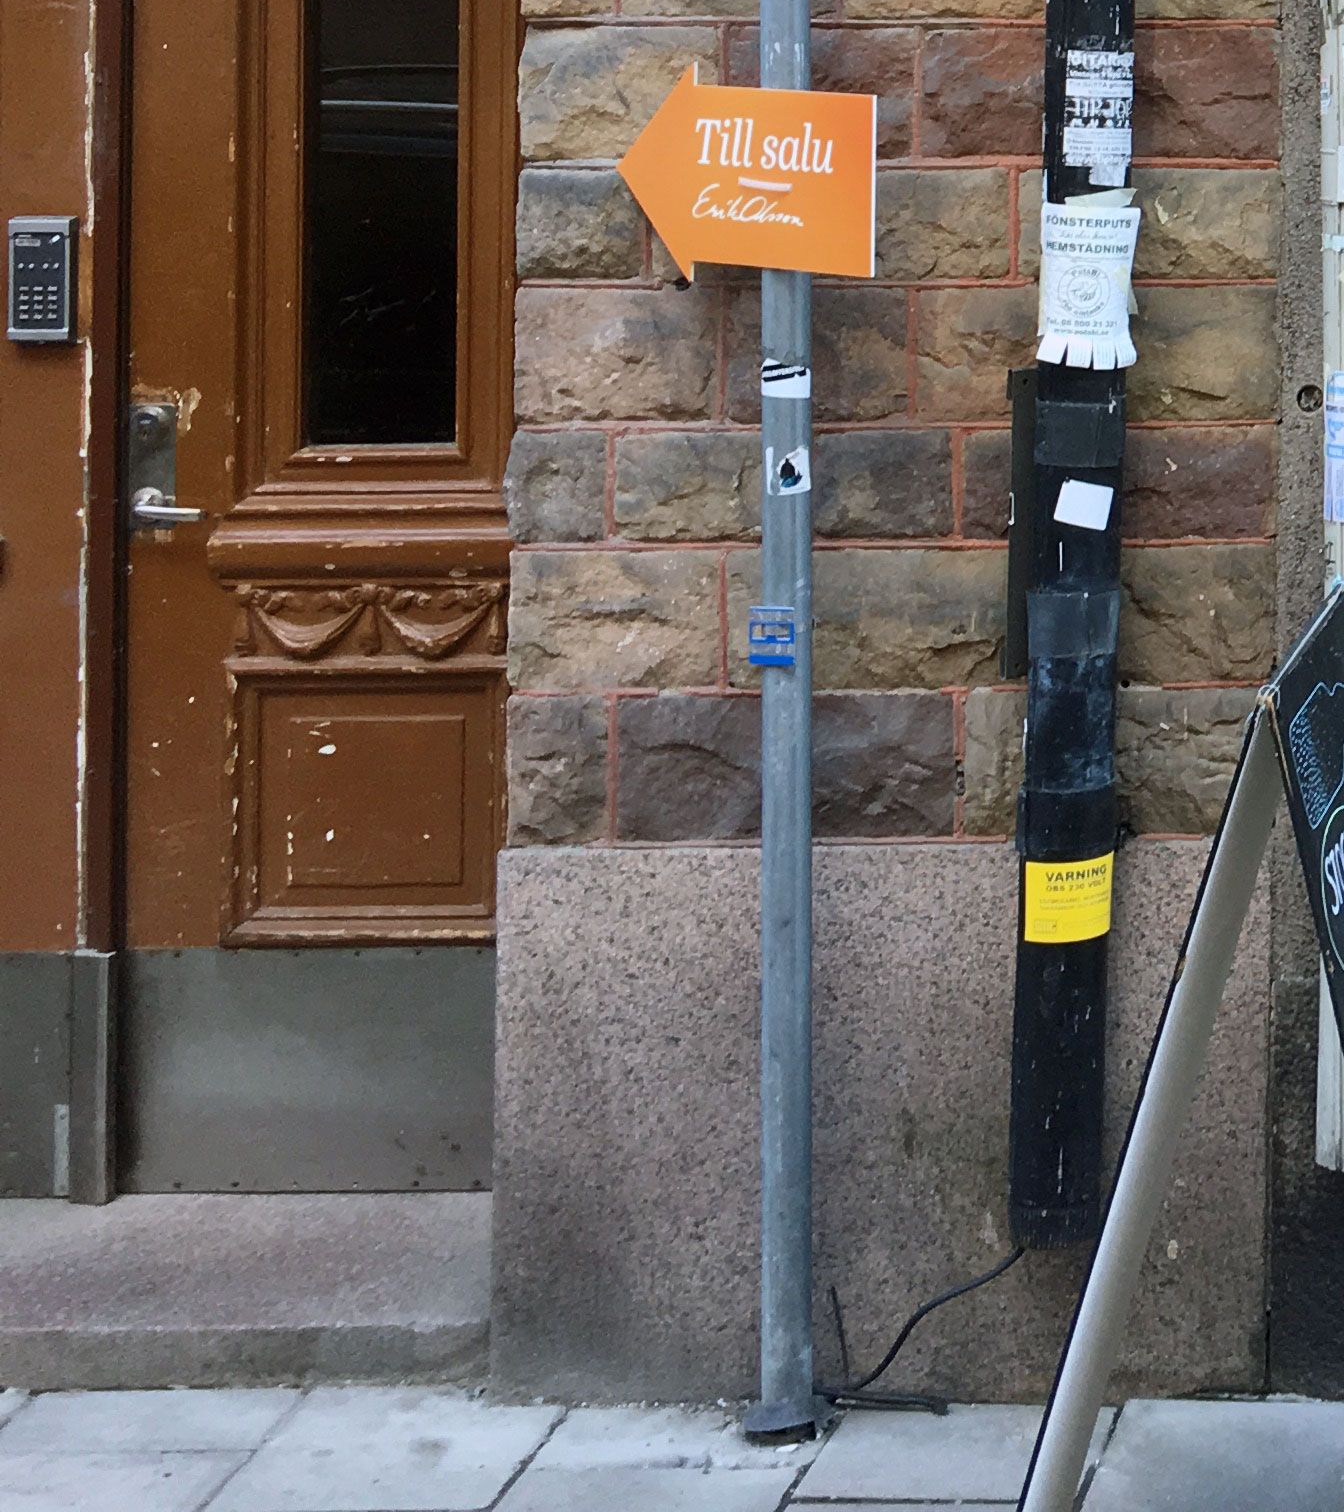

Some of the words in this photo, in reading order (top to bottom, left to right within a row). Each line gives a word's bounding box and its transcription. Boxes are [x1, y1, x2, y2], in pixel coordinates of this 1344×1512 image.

[695, 117, 754, 167] Till
[760, 121, 834, 173] salu
[1046, 214, 1133, 229] FÖNSTERPUTS
[1046, 240, 1130, 255] HEMSTÄDNING
[1046, 864, 1107, 882] VARNING
